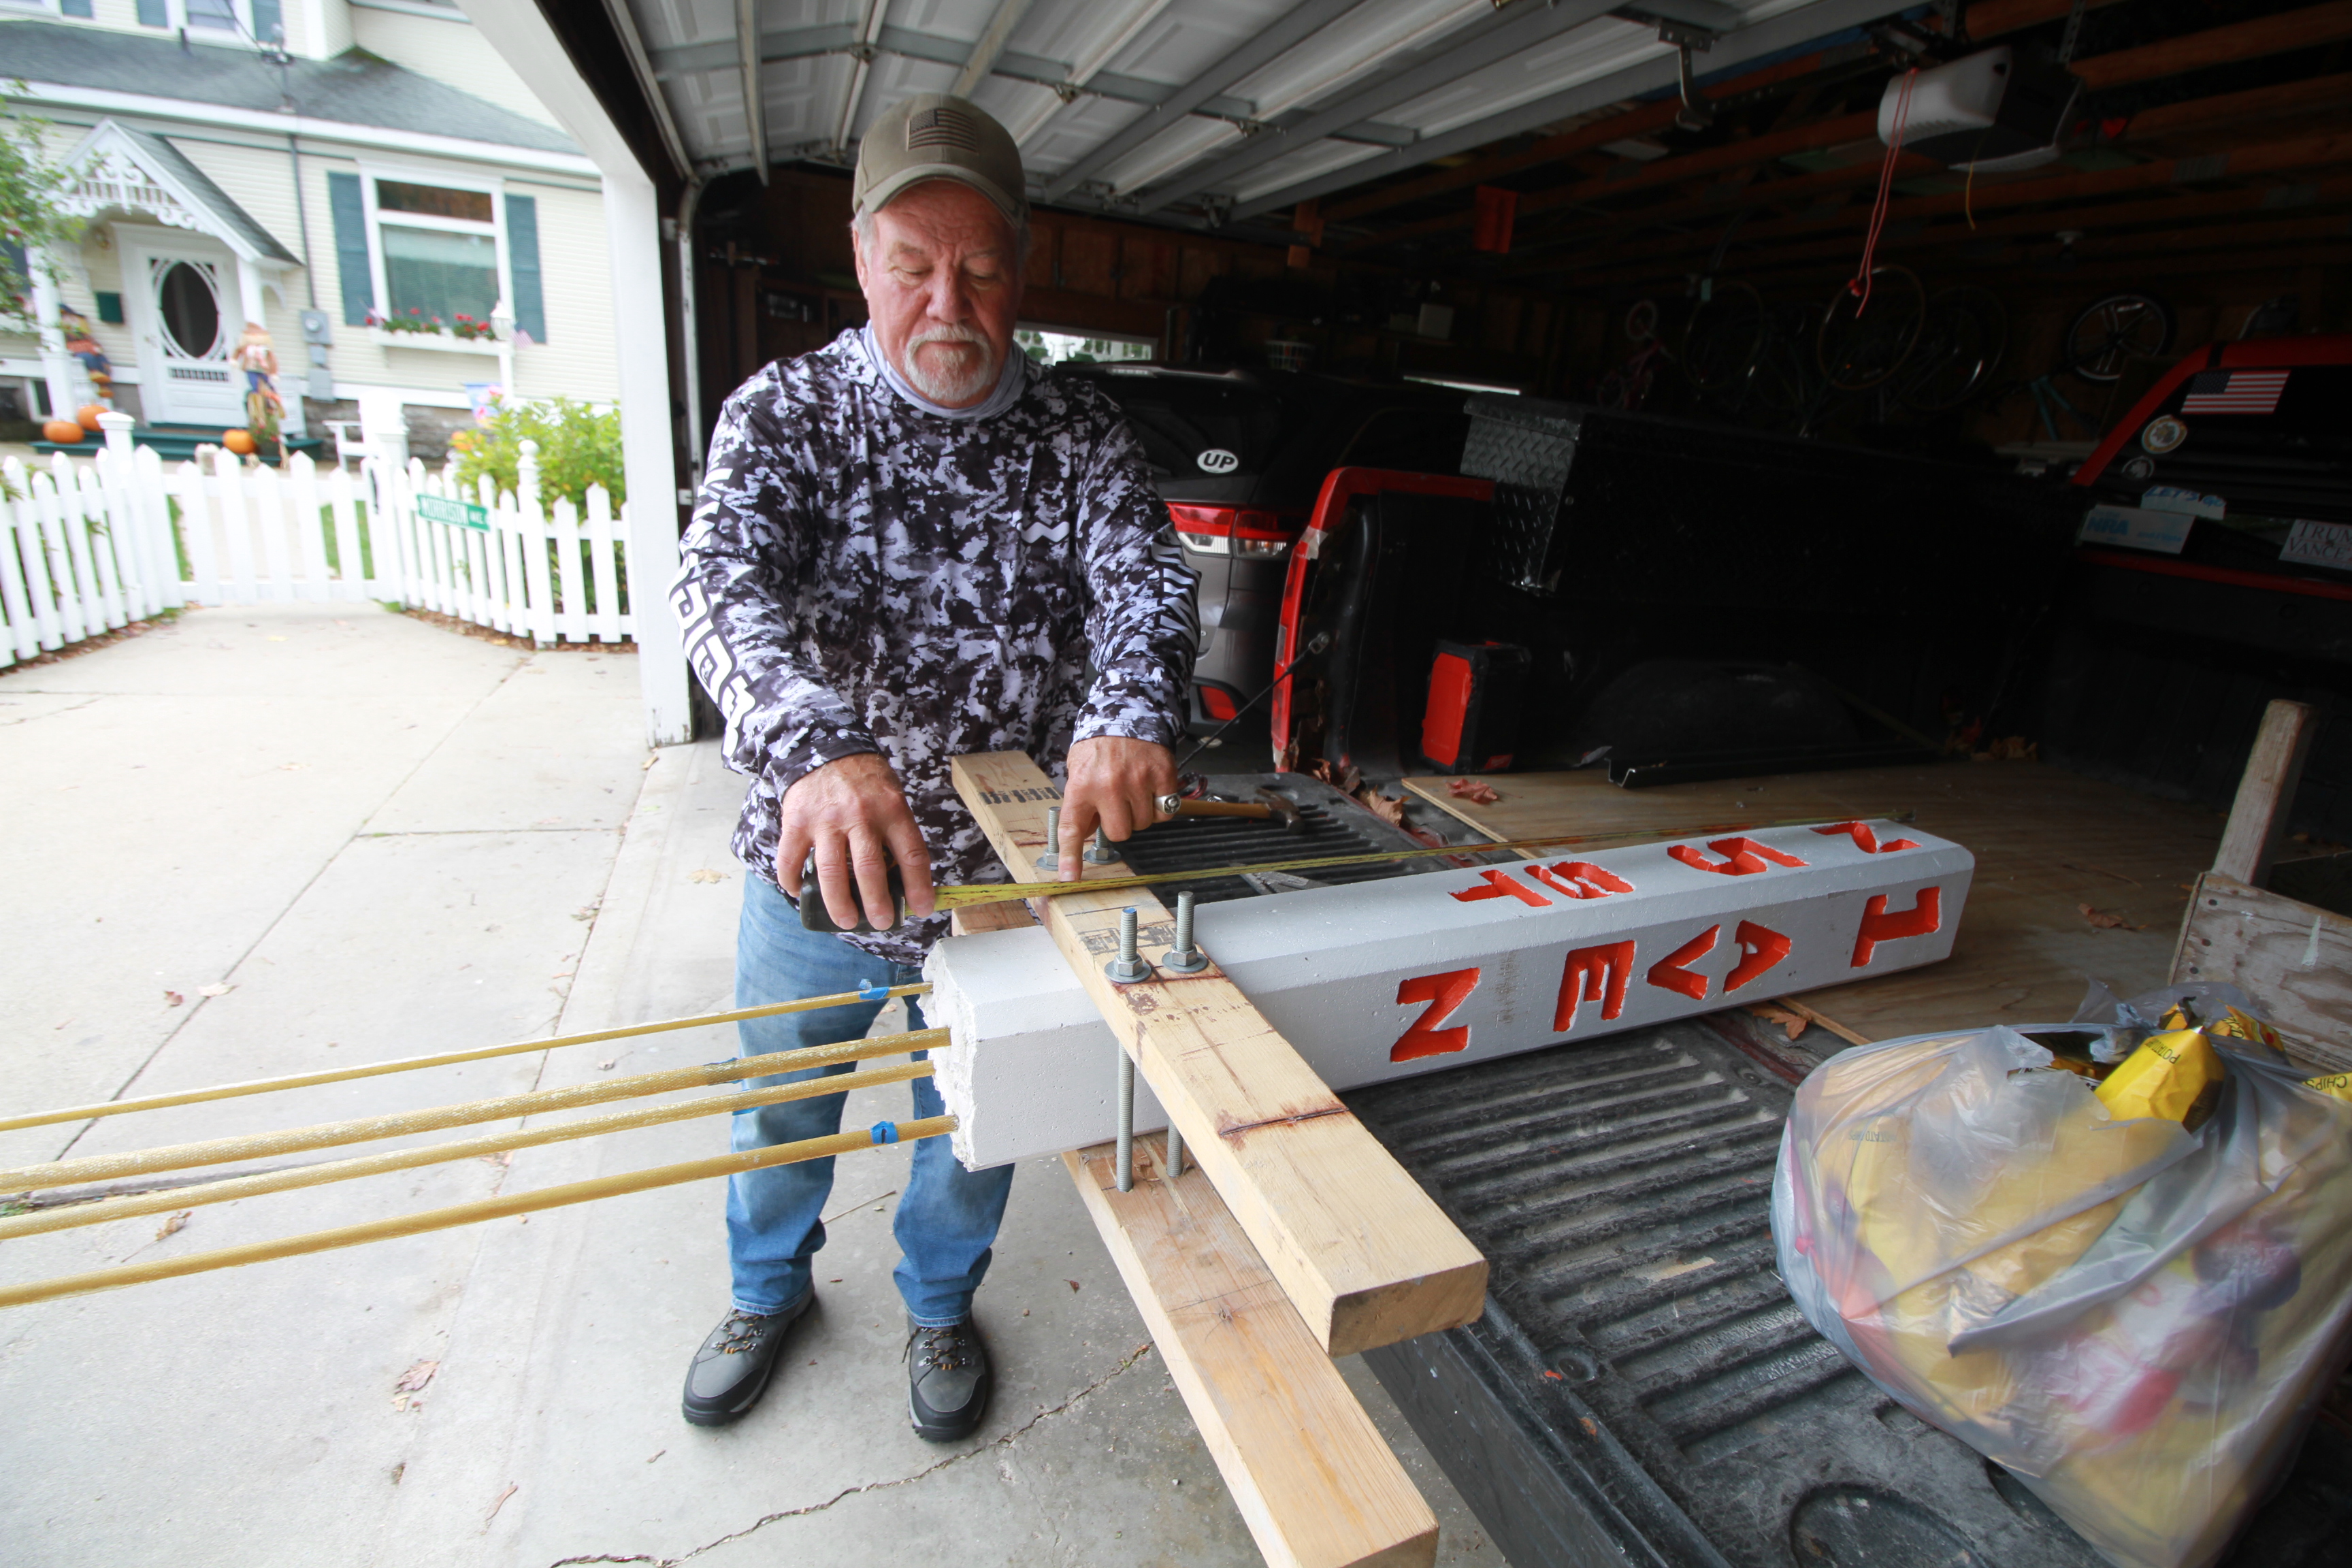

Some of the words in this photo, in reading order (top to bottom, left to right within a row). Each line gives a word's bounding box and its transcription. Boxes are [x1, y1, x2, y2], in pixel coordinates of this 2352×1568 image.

[1203, 453, 1235, 468] UP
[420, 496, 469, 525] MORRISON
[2086, 517, 2130, 536] NRA
[2290, 538, 2345, 560] VANCE
[1667, 836, 1810, 876] 5
[1552, 919, 1792, 1032] AVE
[1390, 966, 1481, 1063] N
[2305, 1076, 2348, 1091] CHIPS
